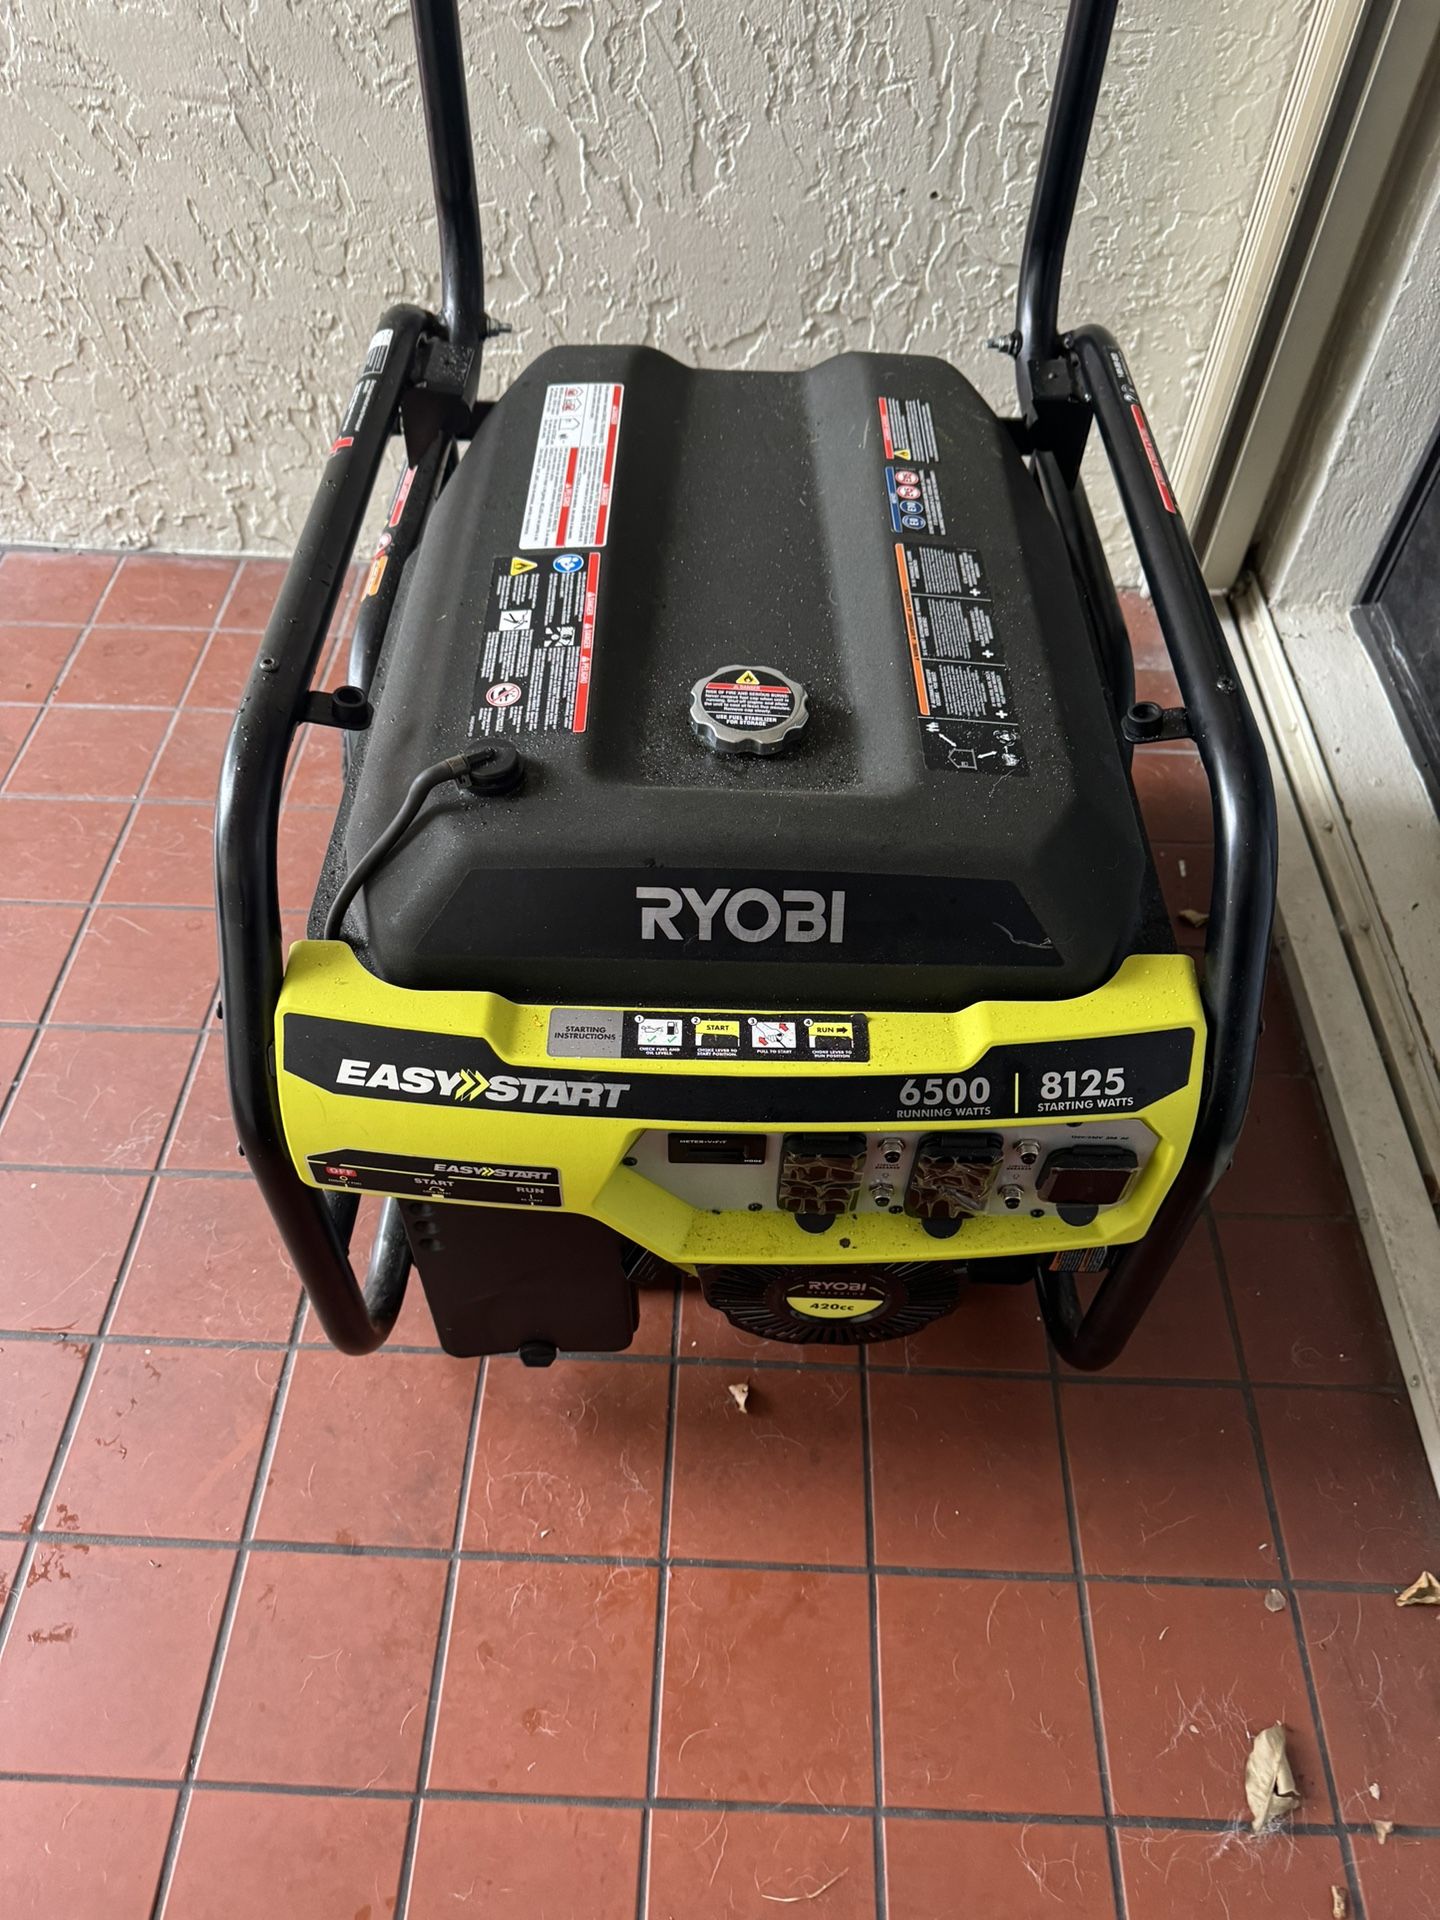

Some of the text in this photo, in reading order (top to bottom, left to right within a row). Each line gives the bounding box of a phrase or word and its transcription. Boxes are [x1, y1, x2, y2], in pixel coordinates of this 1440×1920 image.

[636, 886, 845, 943] RYOBI
[554, 1032, 616, 1040] INSTRUCTIONS
[336, 1059, 631, 1108] EASY START
[1040, 1067, 1125, 1100] 8125
[900, 1077, 991, 1106] 6500
[1037, 1097, 1134, 1112] STARTING WATTS
[896, 1106, 991, 1119] RUNNING WATTS
[328, 1168, 355, 1176] OFF
[434, 1164, 551, 1180] EASY START
[413, 1177, 455, 1187] START
[808, 1281, 867, 1291] RYOBI
[810, 1303, 854, 1311] 420cc
